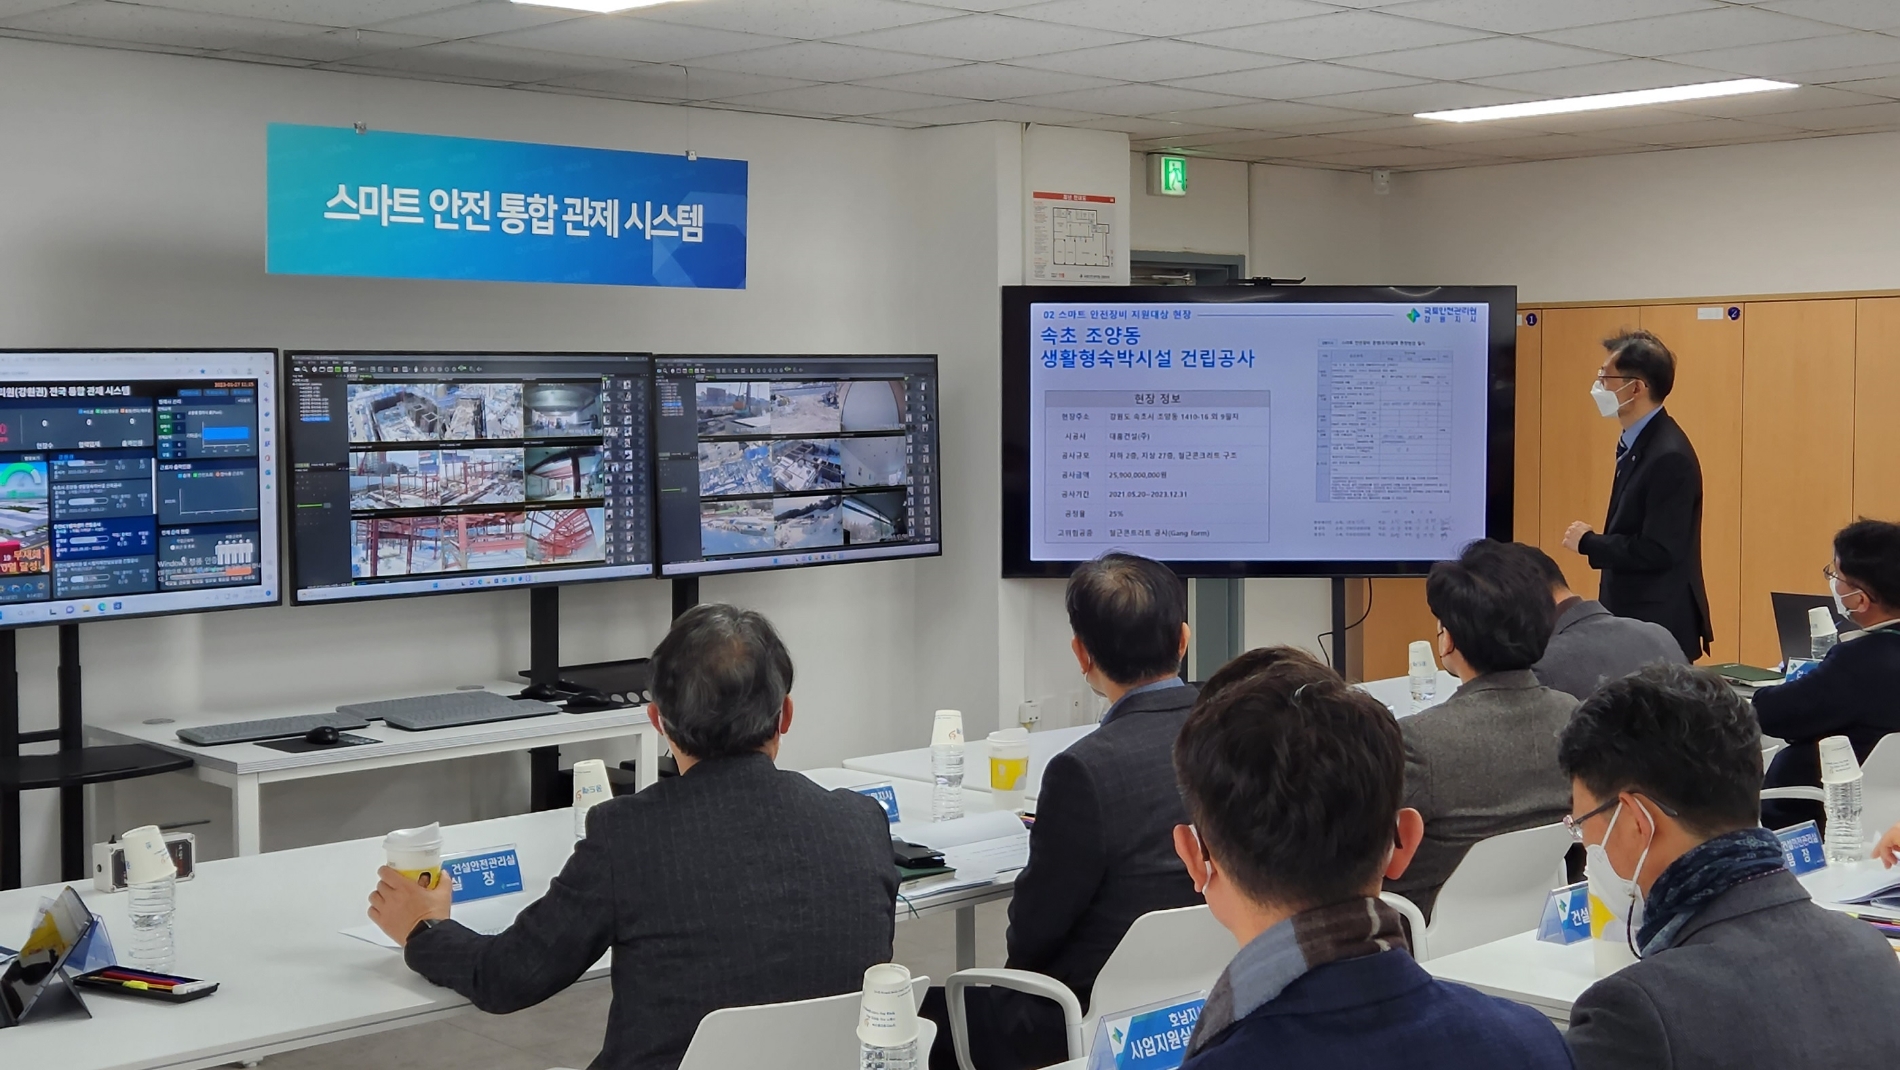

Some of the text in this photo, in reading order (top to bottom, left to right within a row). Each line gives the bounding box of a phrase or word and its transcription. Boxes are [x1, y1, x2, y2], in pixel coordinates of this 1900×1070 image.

[324, 184, 704, 244] 스마트 안전 통합 관제 시스템
[1043, 310, 1192, 320] 02 스마트 안전장비 지원대상 현장
[1040, 326, 1141, 346] 속초 조양동
[1040, 348, 1256, 369] 생활형숙박시설 건립공사
[104, 385, 131, 396] 시스템
[1134, 393, 1182, 405] 현장 정보
[1061, 490, 1090, 499] 공사기간
[1109, 510, 1124, 518] 25%
[452, 854, 516, 876] 건설안전관리실
[451, 876, 463, 892] 실
[482, 870, 495, 886] 장
[1130, 1025, 1196, 1060] 사업지원실
